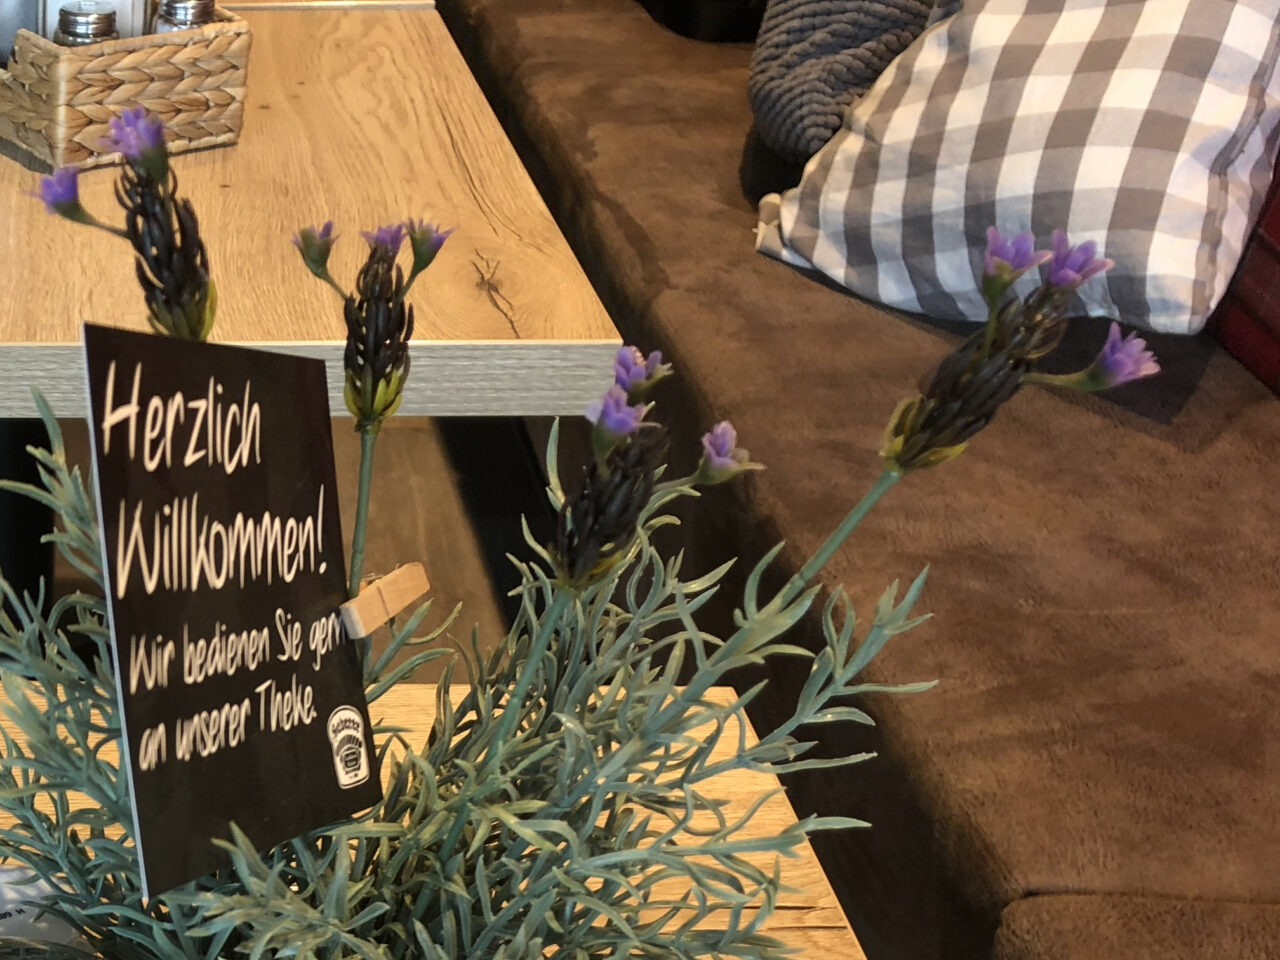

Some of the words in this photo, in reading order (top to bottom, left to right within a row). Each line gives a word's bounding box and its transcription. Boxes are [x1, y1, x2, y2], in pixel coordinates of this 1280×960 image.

[102, 359, 261, 474] Herzlich
[116, 484, 327, 600] Willkommen!
[129, 633, 175, 695] Wir
[183, 620, 270, 684] bedienen
[275, 607, 303, 661] Sie
[139, 722, 166, 771] an
[176, 697, 251, 762] unserer
[254, 673, 317, 732] Theke.
